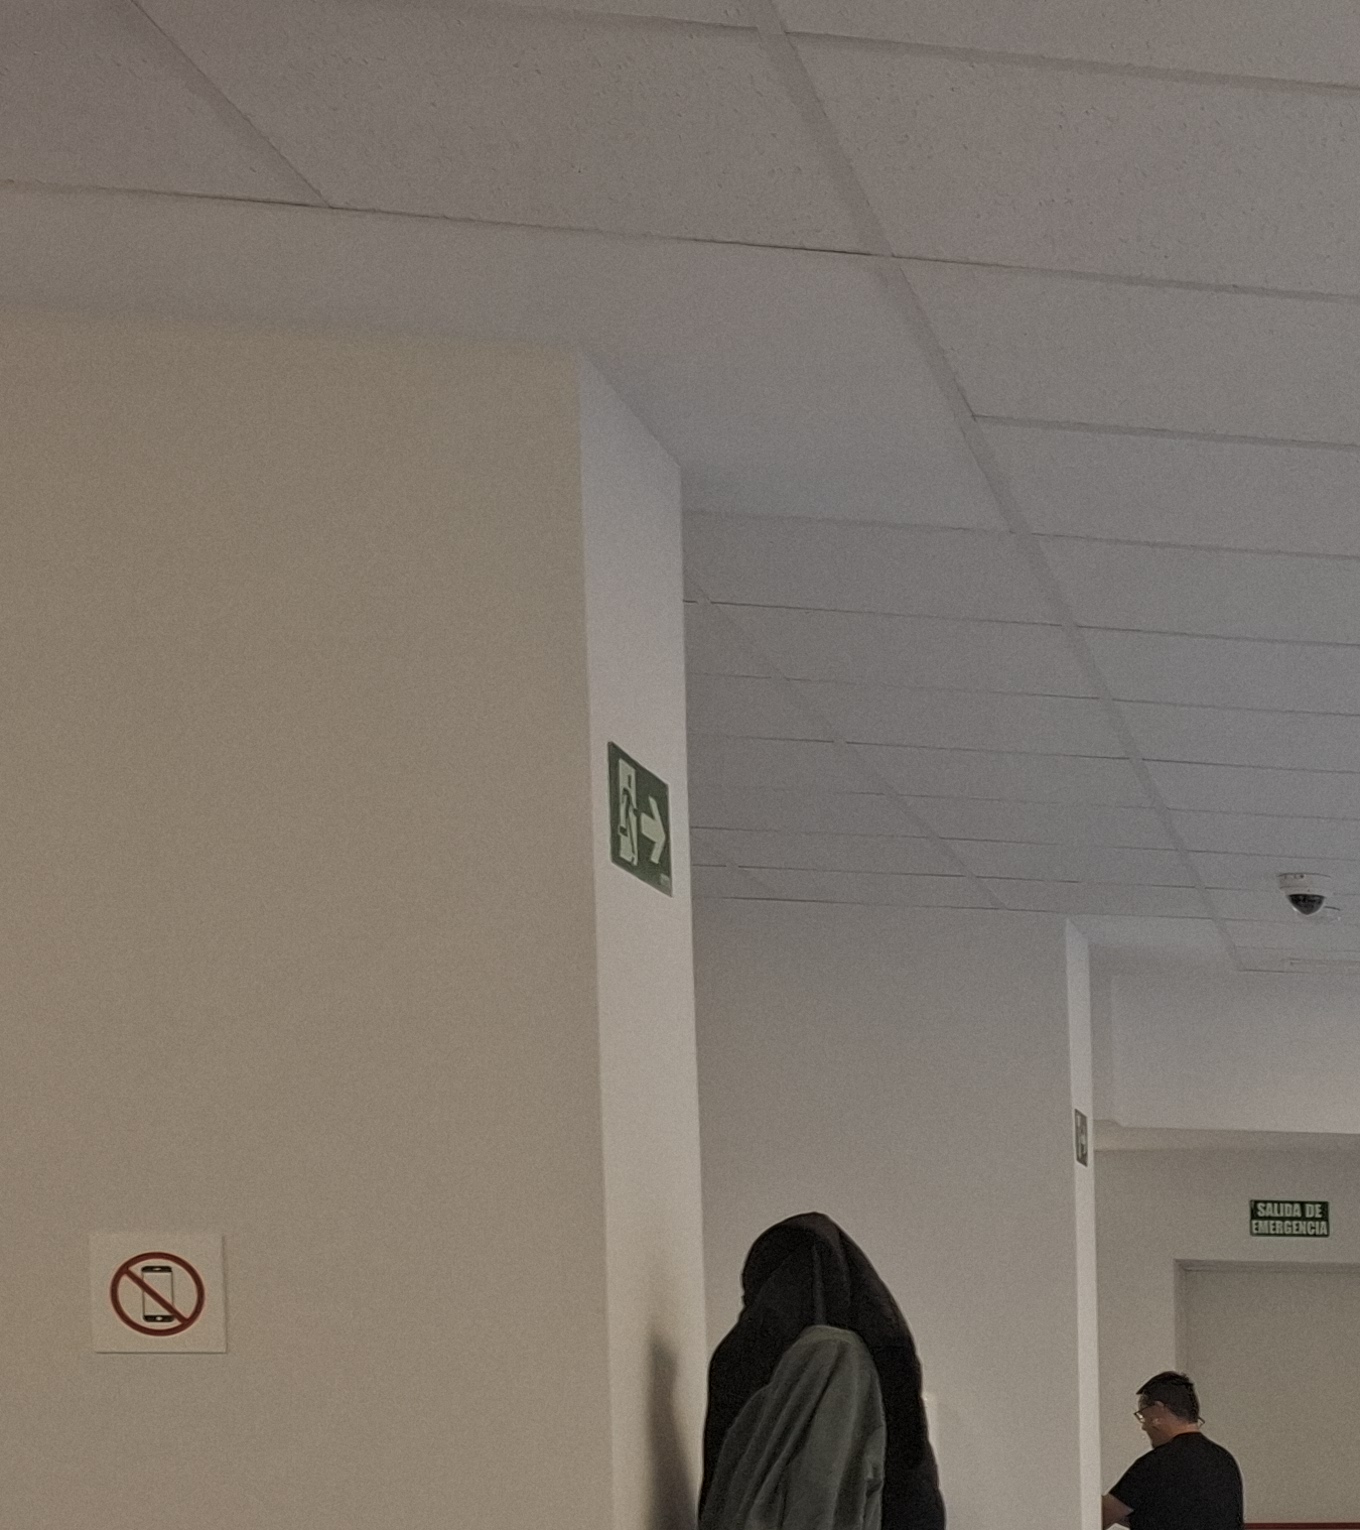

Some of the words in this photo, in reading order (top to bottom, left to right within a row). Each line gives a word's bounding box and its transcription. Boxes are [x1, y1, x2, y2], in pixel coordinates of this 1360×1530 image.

[1257, 1202, 1301, 1217] SALIDA
[1305, 1203, 1322, 1218] DE
[1252, 1220, 1327, 1235] EMERGENCIA
